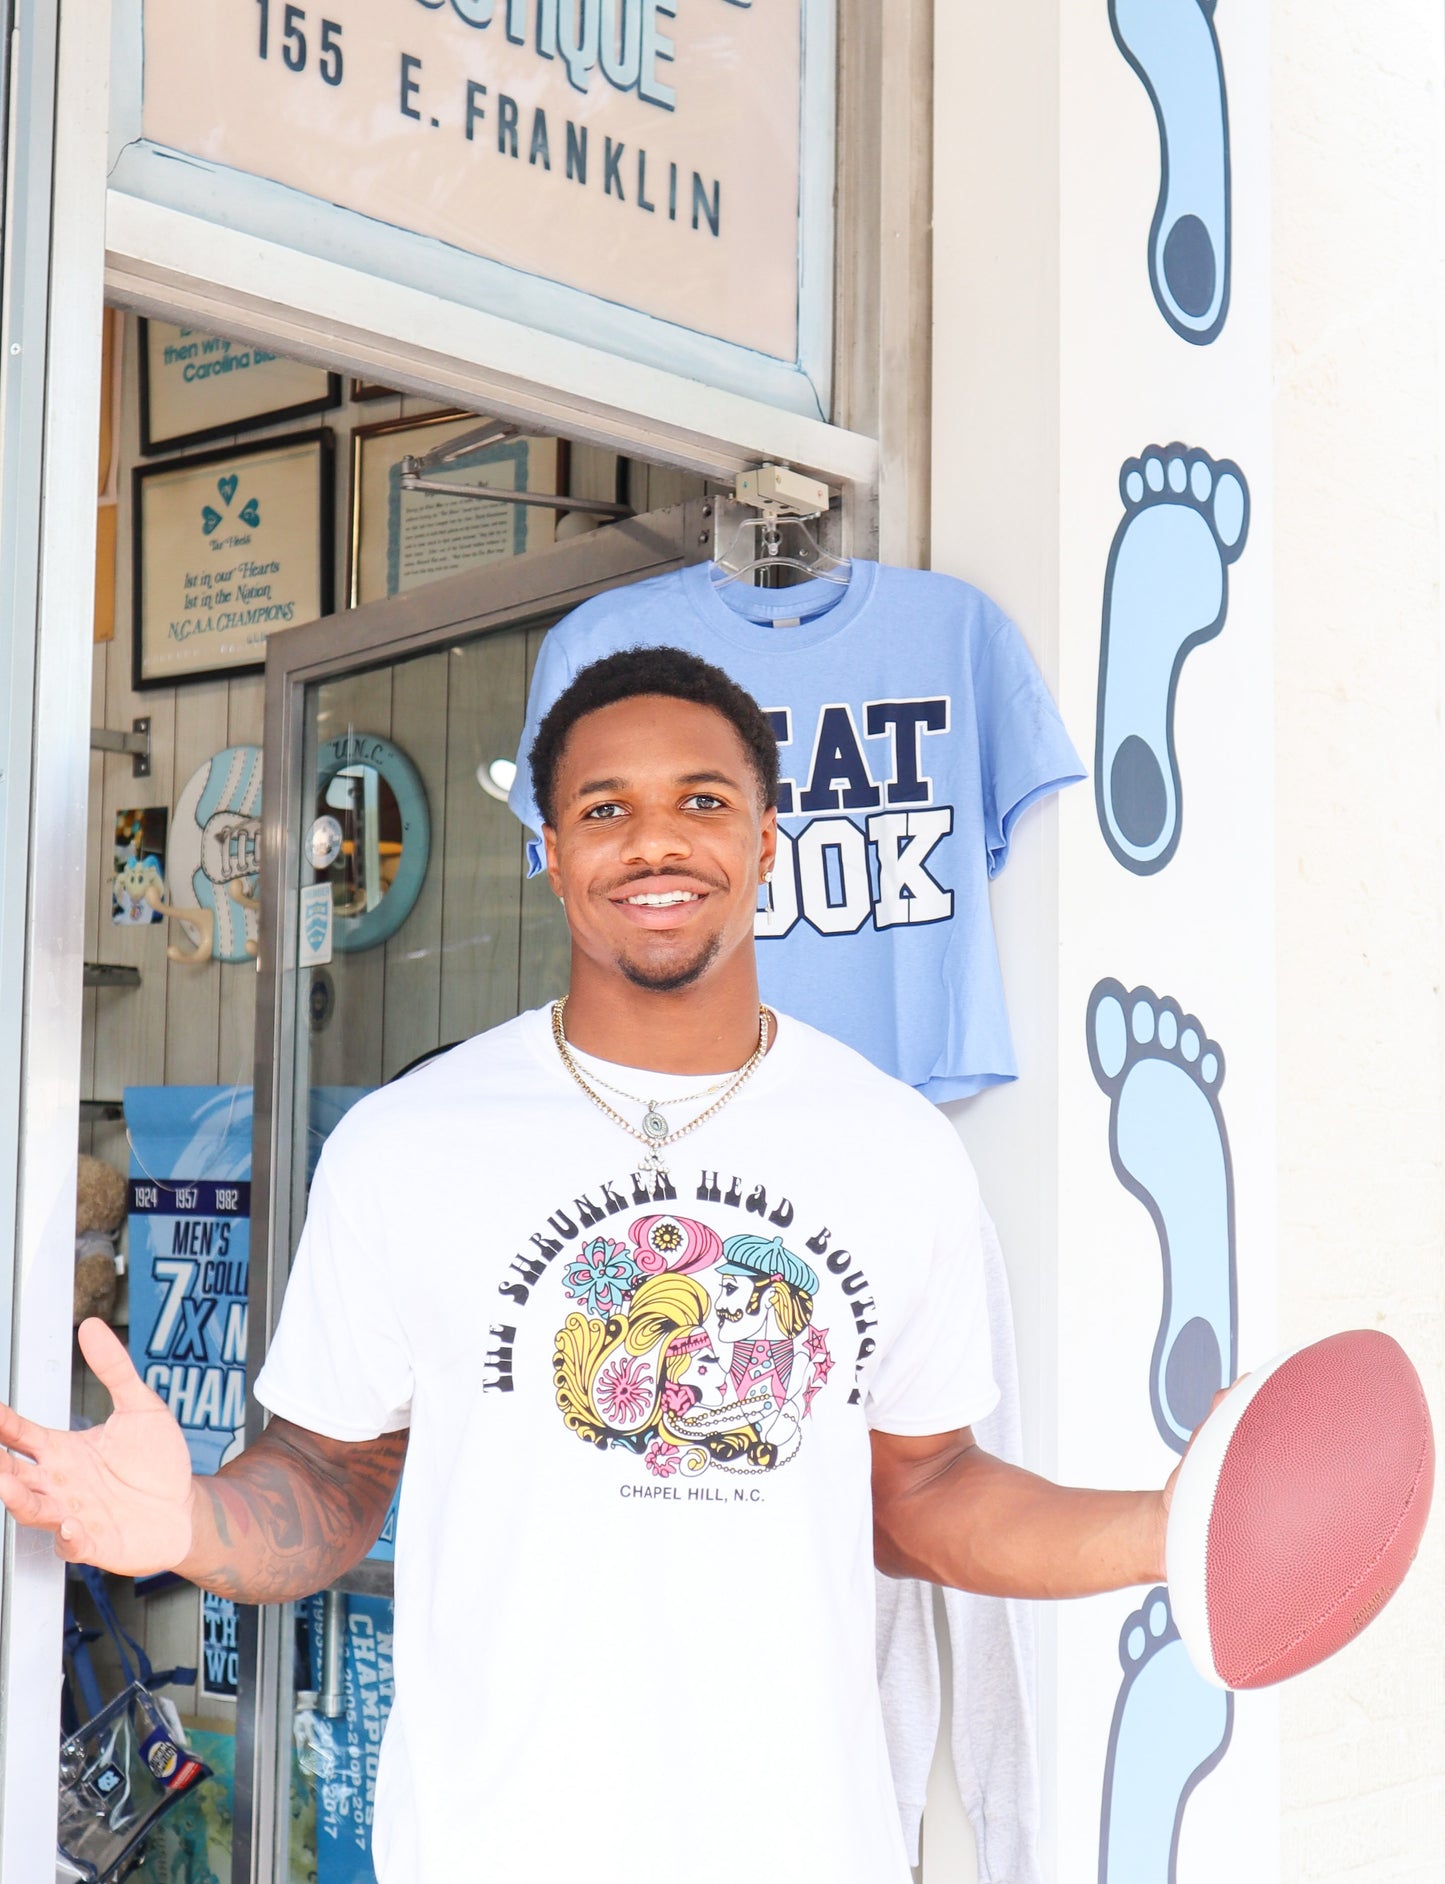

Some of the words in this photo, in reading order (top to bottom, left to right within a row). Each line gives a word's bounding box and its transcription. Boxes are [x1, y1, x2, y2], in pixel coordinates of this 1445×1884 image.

[256, 0, 343, 86] 155
[400, 52, 439, 128] E.
[466, 79, 720, 238] FRANKLIN
[164, 344, 198, 365] then
[183, 352, 250, 383] Carolina
[237, 561, 280, 579] Hearts
[215, 589, 231, 605] the
[235, 584, 272, 605] Nation
[216, 602, 295, 632] CHAMPIONS
[134, 1187, 158, 1208] 1924
[175, 1188, 198, 1209] 1957
[215, 1189, 239, 1210] 1982
[171, 1220, 232, 1257] MEN'S
[498, 1171, 678, 1307] SHRUNKEN
[696, 1170, 795, 1229] HEAD
[805, 1226, 878, 1406] BOUTIQ
[620, 1484, 682, 1500] CHAPEL
[688, 1487, 728, 1504] HILL,
[734, 1488, 765, 1502] N.C.
[348, 1613, 380, 1827] CHAMPIONS
